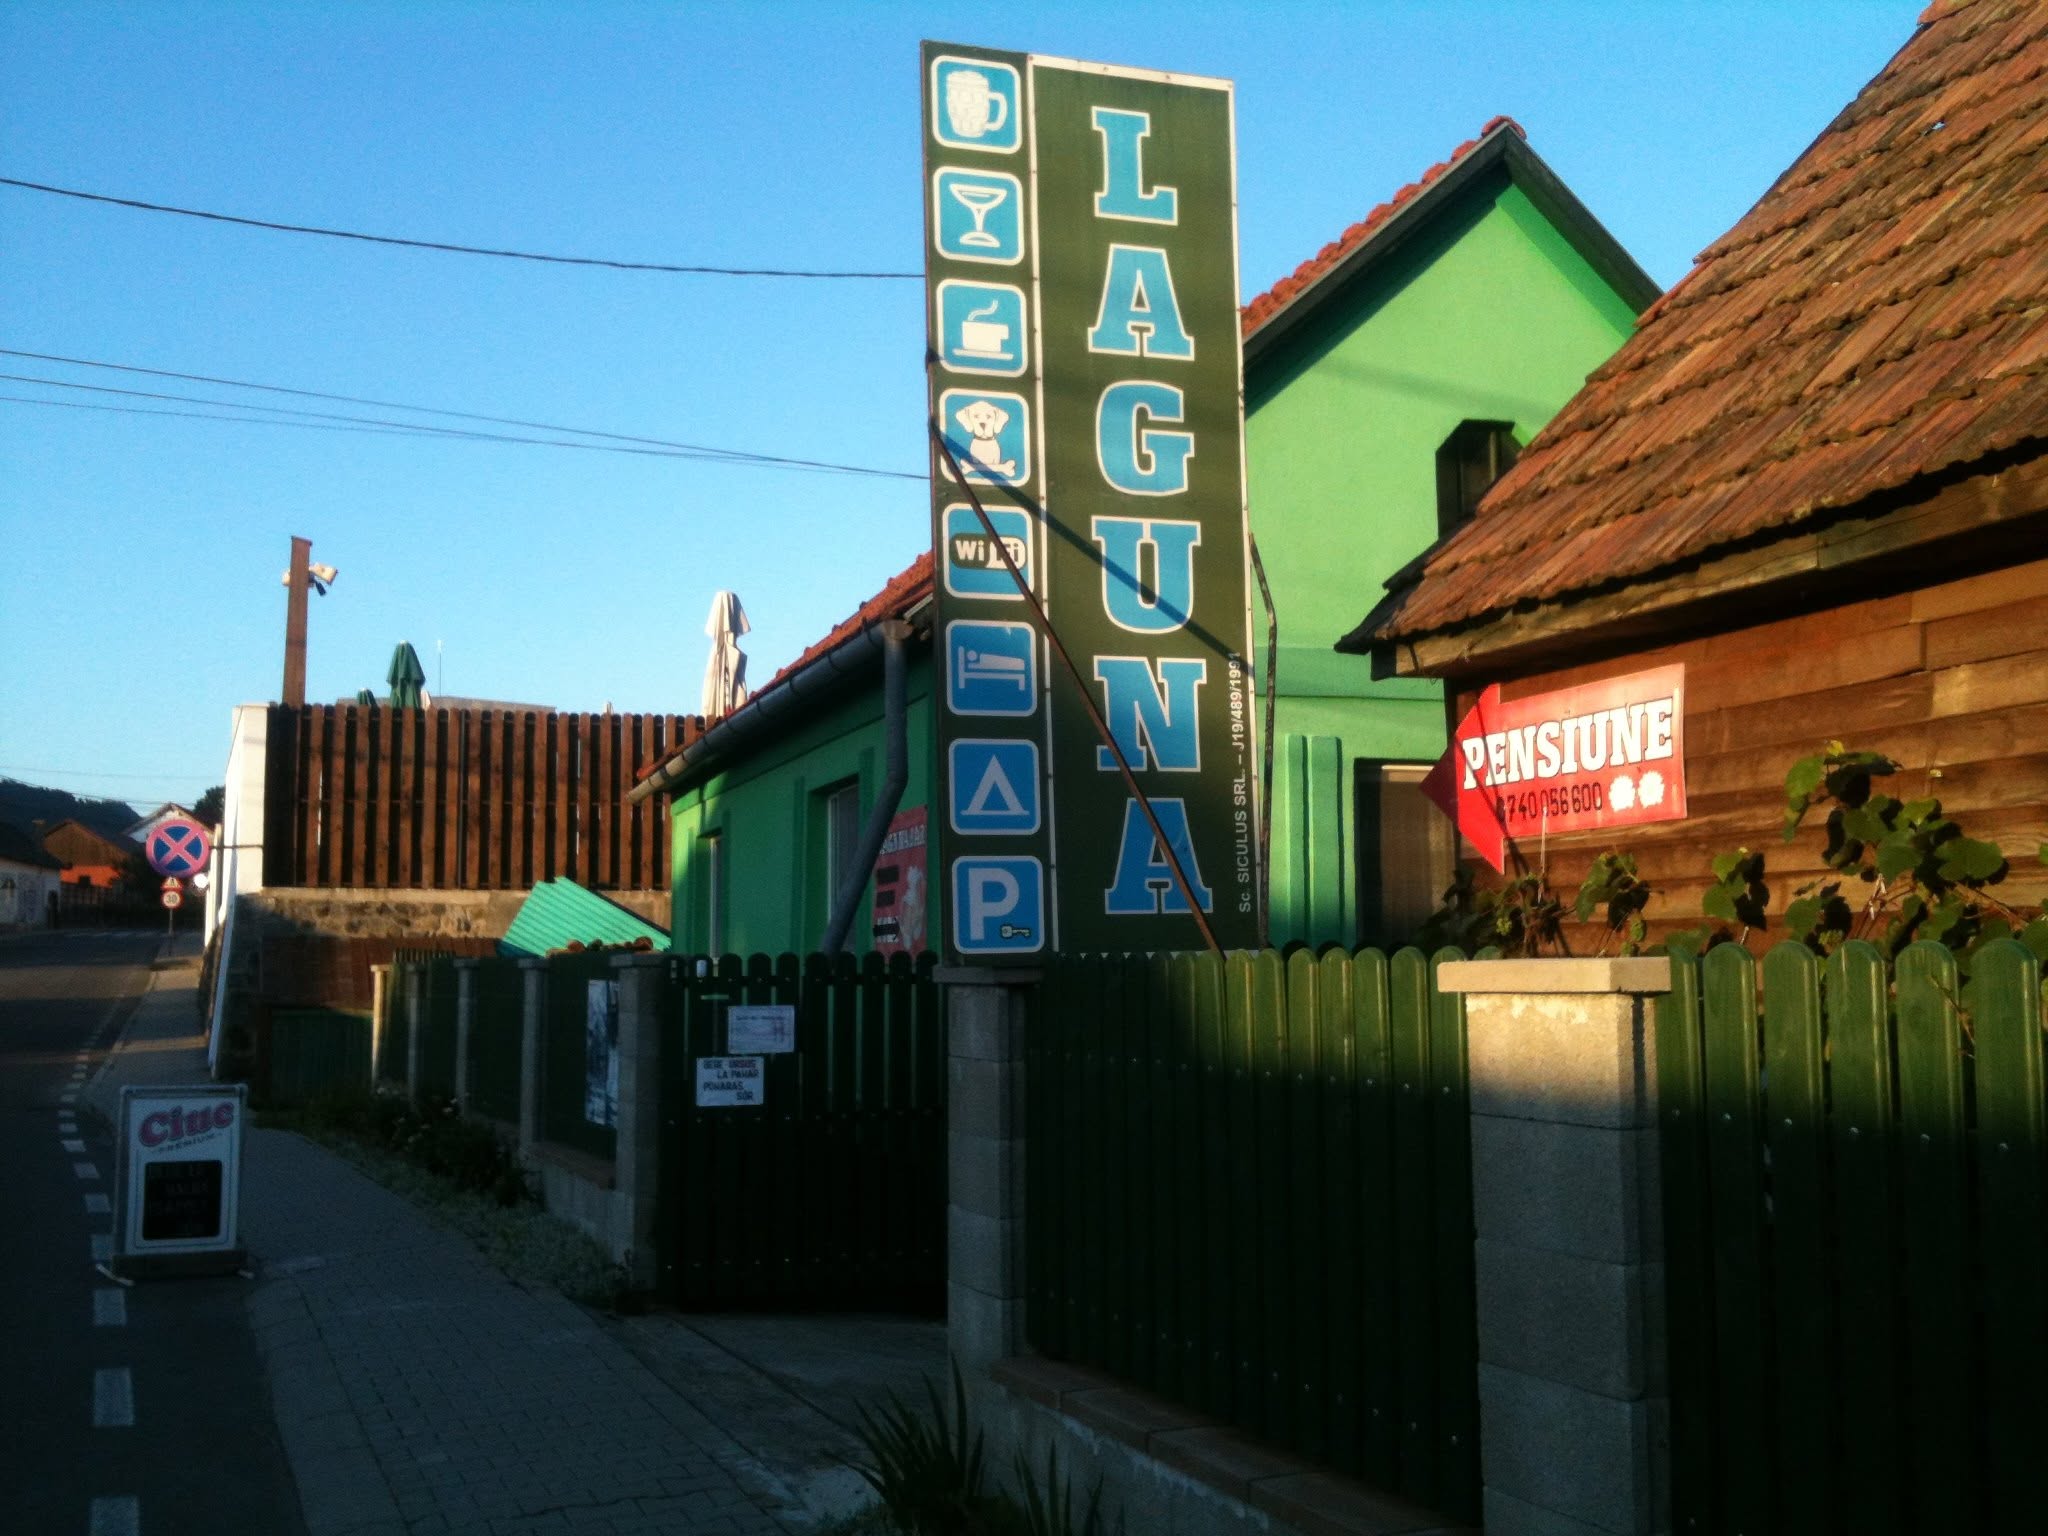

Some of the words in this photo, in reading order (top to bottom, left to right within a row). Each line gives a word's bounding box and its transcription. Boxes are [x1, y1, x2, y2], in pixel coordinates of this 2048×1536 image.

[1087, 105, 1213, 915] LAGUNA
[1228, 651, 1245, 751] J19/489/1991
[1461, 696, 1674, 790] PENSIUNE
[1234, 810, 1250, 884] SICULUS
[165, 894, 178, 905] 30
